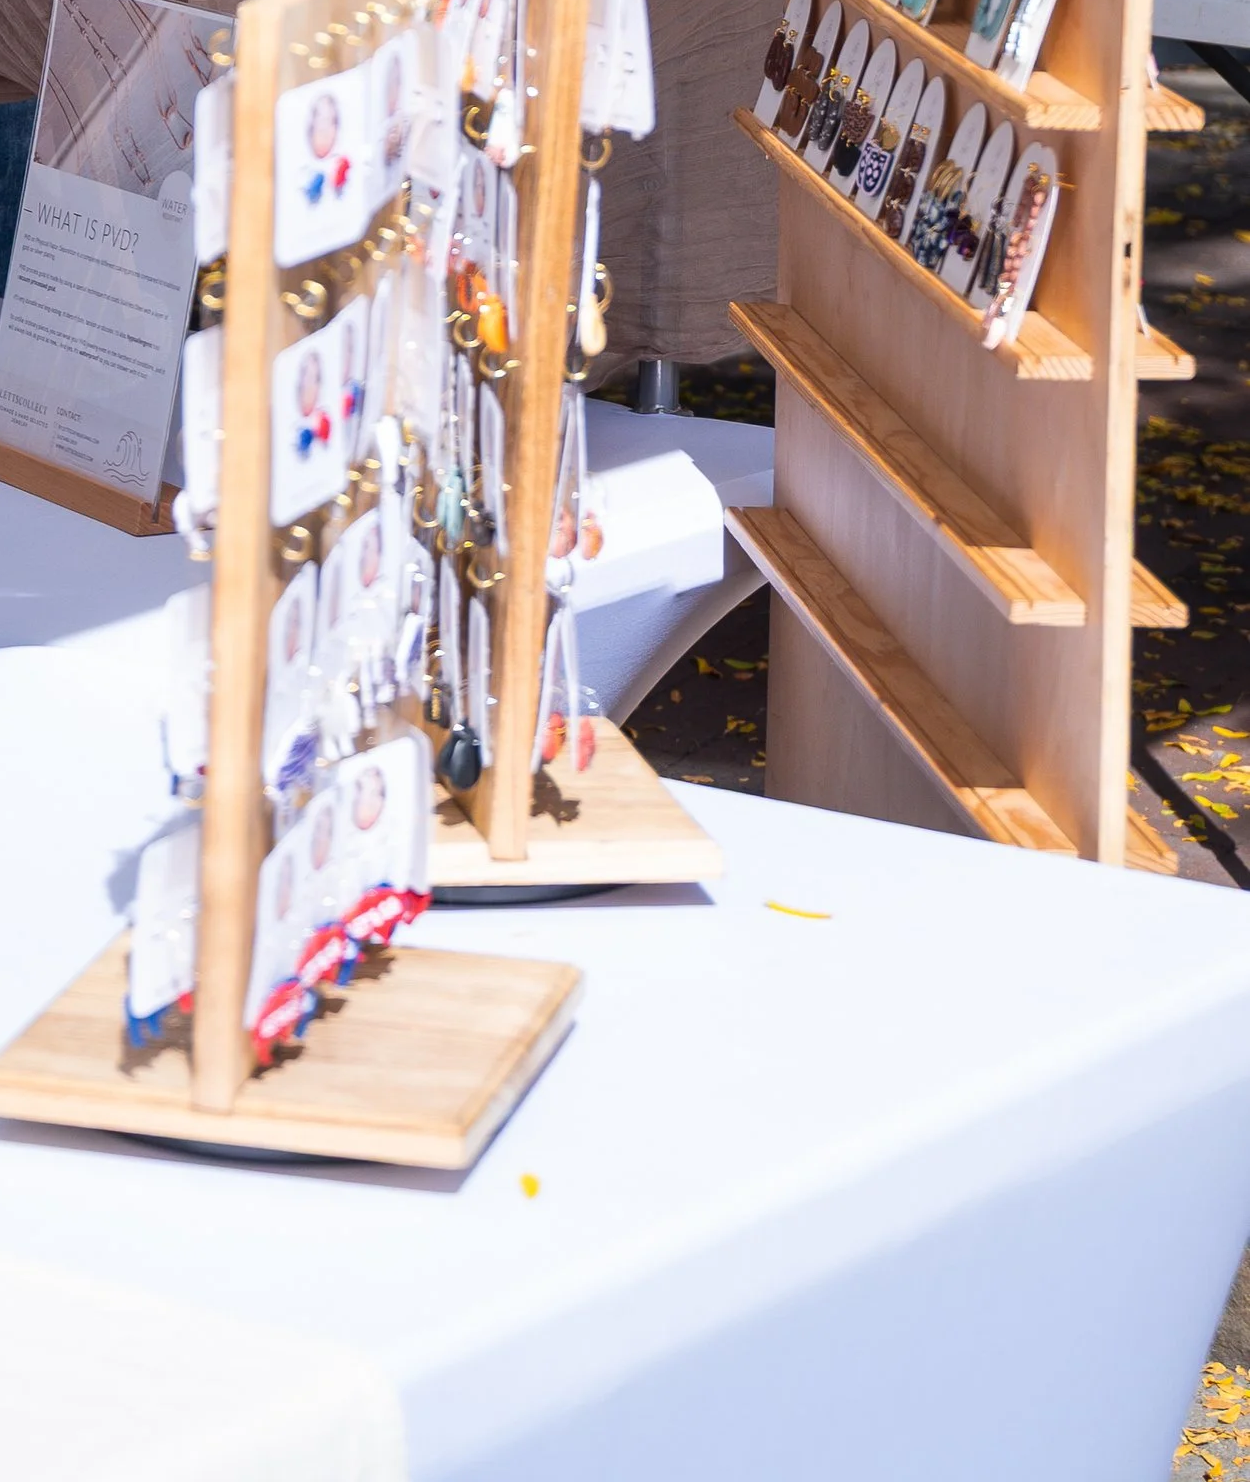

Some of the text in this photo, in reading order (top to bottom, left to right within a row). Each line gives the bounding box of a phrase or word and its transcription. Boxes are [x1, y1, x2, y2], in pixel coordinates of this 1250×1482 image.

[161, 198, 188, 215] WATER
[37, 202, 139, 254] WHAT IS PVD?
